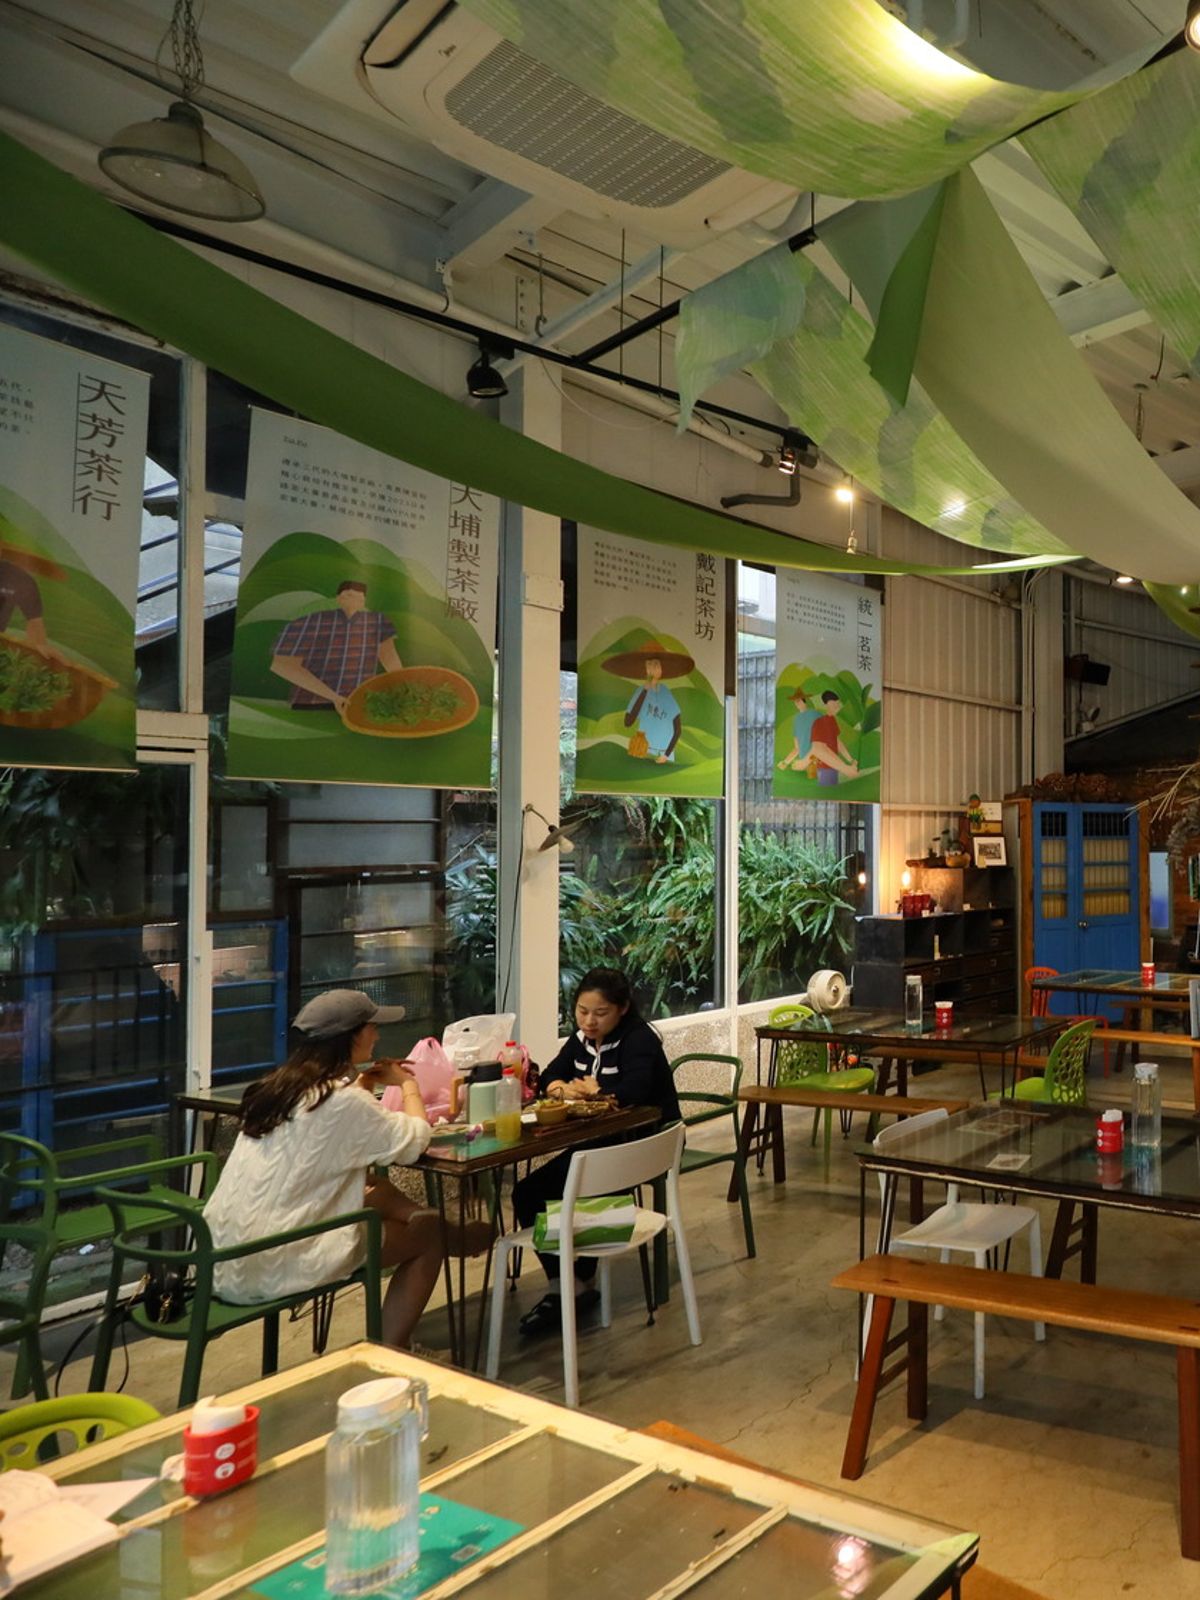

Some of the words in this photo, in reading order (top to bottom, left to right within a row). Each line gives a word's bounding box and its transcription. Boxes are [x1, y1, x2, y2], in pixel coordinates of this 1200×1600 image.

[75, 375, 127, 521] 天芳茶行
[448, 485, 482, 623] 大埔製茶廠
[857, 596, 873, 672] 統一茗茶
